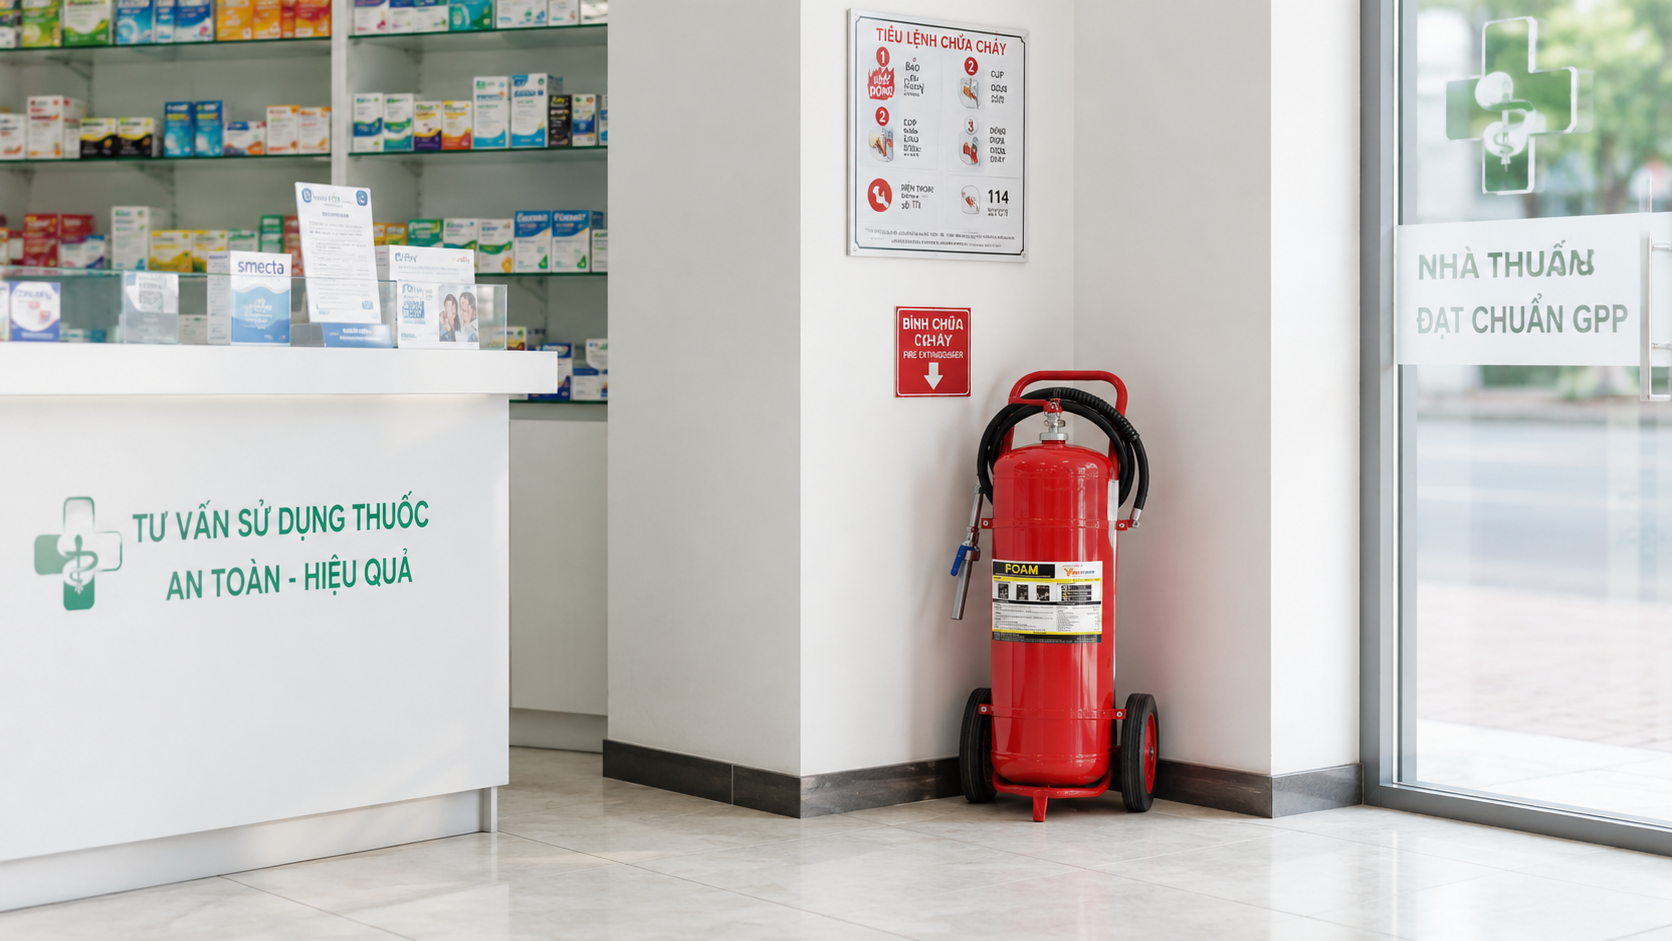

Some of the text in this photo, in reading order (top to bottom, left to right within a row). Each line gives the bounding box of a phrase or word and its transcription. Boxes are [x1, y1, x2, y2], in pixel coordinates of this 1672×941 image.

[880, 50, 886, 63] 1
[968, 60, 975, 73] 2
[879, 110, 886, 123] 2
[968, 119, 975, 133] 3
[988, 189, 1009, 205] 114
[238, 260, 284, 275] smecta
[1419, 246, 1479, 280] NHÀ
[1416, 293, 1628, 340] ĐẠT CHUẨN GPP
[132, 491, 429, 542] TƯ VẤN SỬ DỤNG THUỐC
[166, 570, 202, 600] AN
[211, 559, 280, 597] TOÀN
[304, 554, 356, 596] HIỆU
[364, 548, 412, 587] QUẢ
[1005, 563, 1039, 575] FOAM
